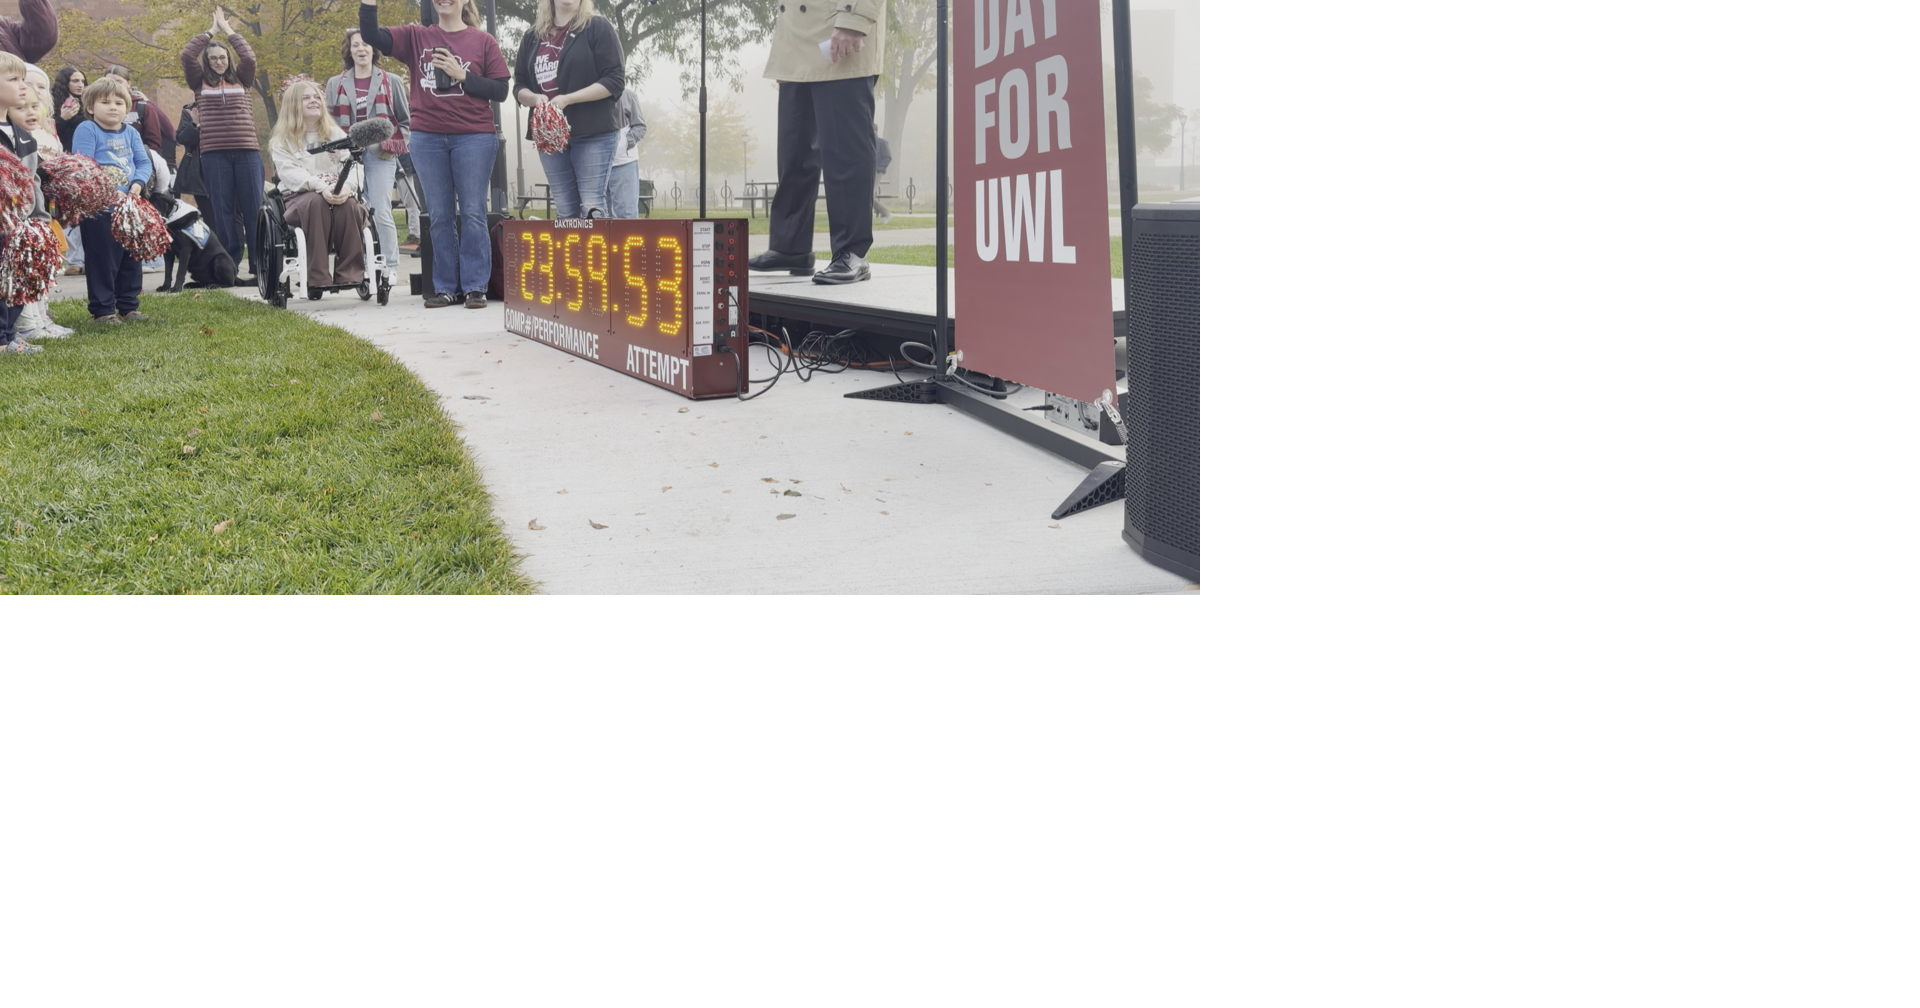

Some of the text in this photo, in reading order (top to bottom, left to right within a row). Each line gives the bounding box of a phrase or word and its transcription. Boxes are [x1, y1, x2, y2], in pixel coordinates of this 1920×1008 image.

[535, 54, 550, 65] IVE
[975, 54, 1073, 165] FOR
[554, 219, 594, 229] DAKTRONICS
[975, 169, 1077, 264] UWL
[521, 232, 682, 335] 23:59:53
[626, 344, 690, 390] ATTEMPT
